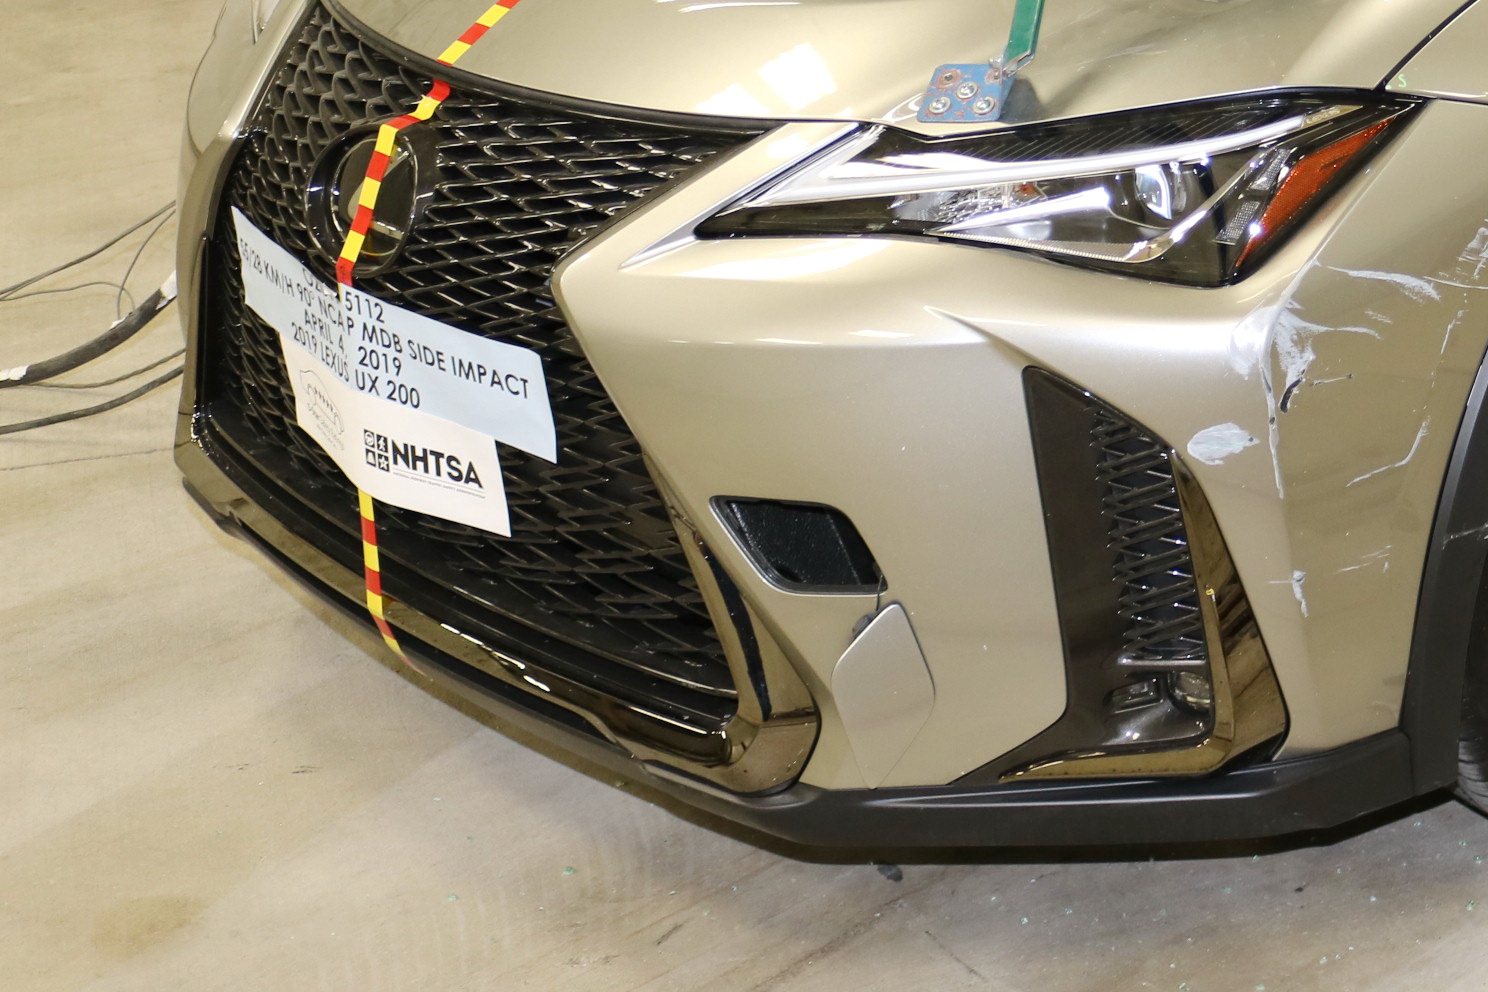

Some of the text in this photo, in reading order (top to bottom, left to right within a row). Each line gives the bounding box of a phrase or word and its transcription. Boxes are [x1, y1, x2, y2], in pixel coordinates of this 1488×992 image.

[263, 260, 295, 297] KM/H
[318, 297, 355, 336] NCAP
[362, 322, 403, 354] MDB
[407, 339, 447, 372] SIDE
[451, 356, 529, 399] IMPACT
[291, 321, 421, 409] 2019 LEXUS UX 200
[304, 308, 402, 377] APRIL 4, 2019
[391, 438, 485, 489] NHTSA
